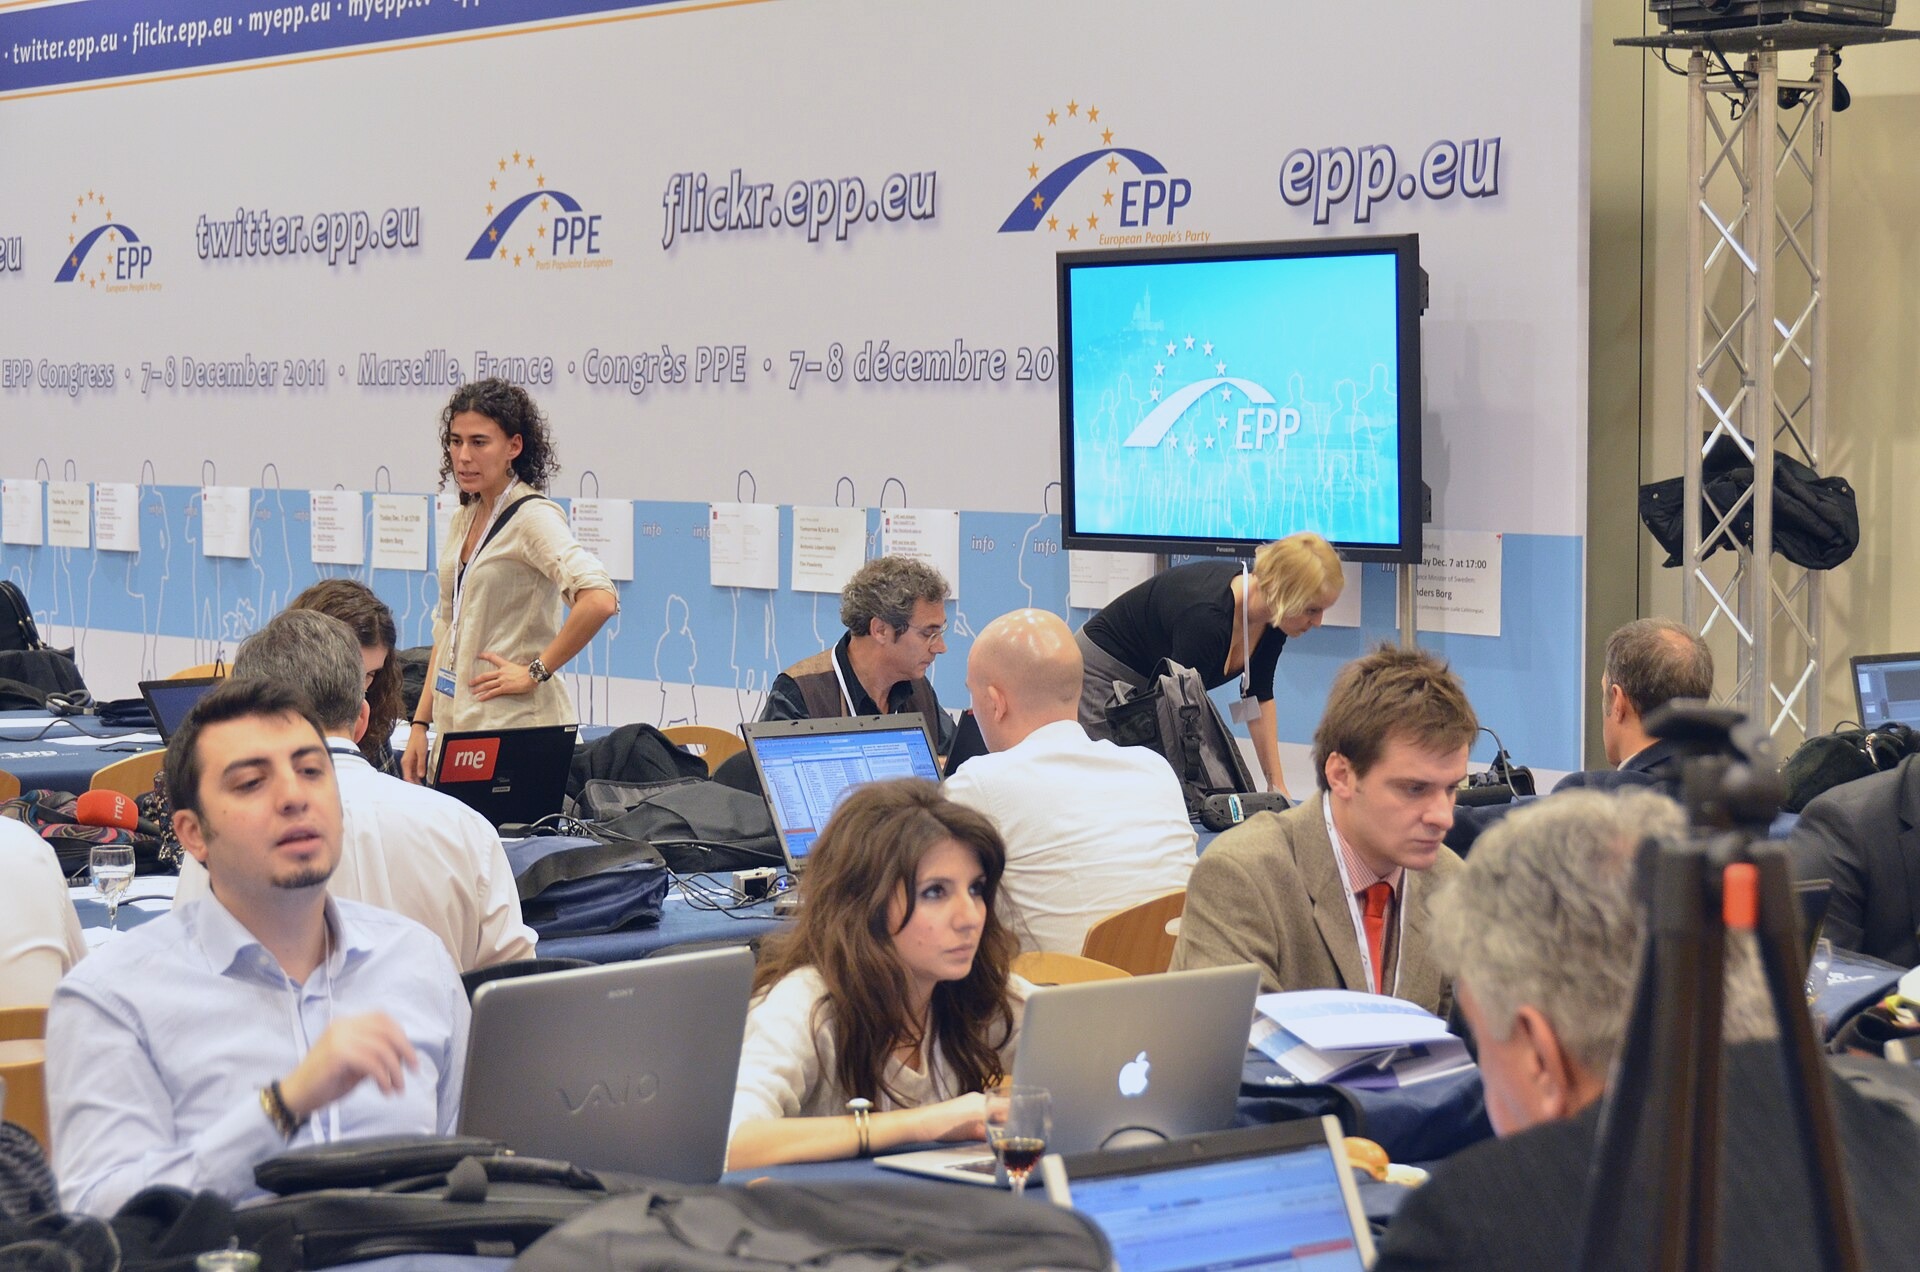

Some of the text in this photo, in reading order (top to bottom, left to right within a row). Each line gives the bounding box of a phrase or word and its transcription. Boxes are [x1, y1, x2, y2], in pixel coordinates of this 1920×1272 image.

[14, 33, 118, 64] twitter.epp.eu
[132, 16, 233, 54] flickr.epp.eu
[249, 2, 331, 36] myepp.eu
[1279, 136, 1501, 226] epp.eu
[662, 168, 937, 250] flickr.epp.eu
[1119, 178, 1192, 227] EPP
[196, 206, 421, 266] twitter.epp.eu
[552, 214, 602, 256] PPE
[1098, 230, 1211, 248] European People's Party
[116, 245, 153, 280] EPP
[2, 359, 33, 388] EPP
[37, 358, 115, 397] Congress
[182, 353, 278, 388] December
[283, 358, 326, 387] 2011
[473, 350, 554, 385] France
[583, 344, 687, 395] Congrès
[695, 345, 747, 383] PPE
[853, 338, 1007, 382] décembre
[1016, 345, 1058, 382] 20
[1236, 407, 1301, 450] EPP
[642, 522, 662, 538] info
[971, 535, 1057, 557] info info
[1432, 557, 1447, 567] Dec.
[1449, 558, 1454, 567] 7
[1456, 560, 1463, 568] at
[1466, 560, 1487, 569] 17:00
[1416, 587, 1452, 600] nders Borg
[454, 749, 486, 769] rne
[114, 795, 126, 820] rne
[556, 1073, 661, 1115] VAIO
